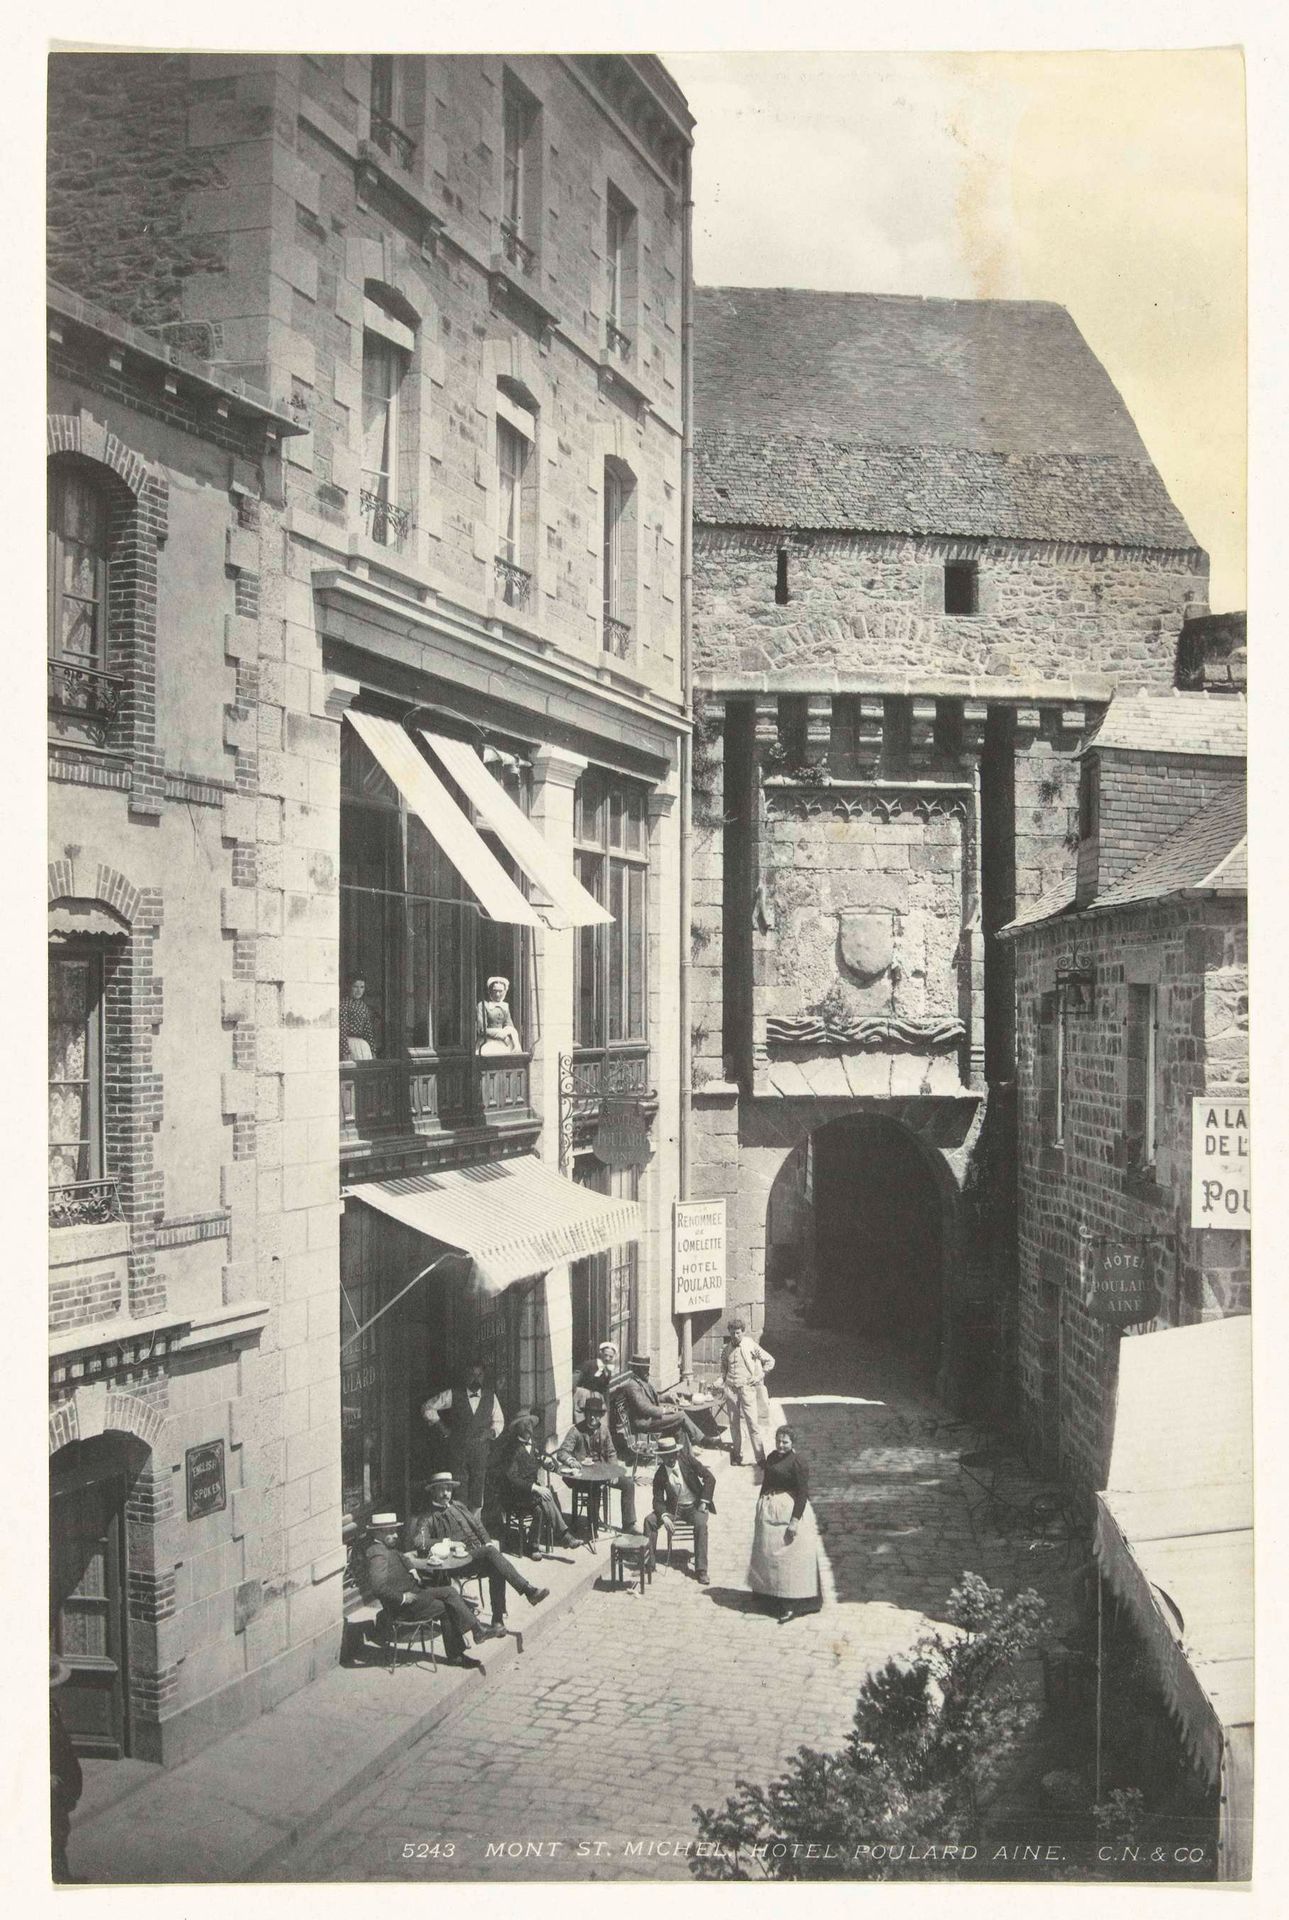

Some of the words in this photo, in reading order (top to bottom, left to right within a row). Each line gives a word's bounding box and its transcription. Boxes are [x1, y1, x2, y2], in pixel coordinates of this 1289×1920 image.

[1205, 1108, 1218, 1128] A
[1225, 1108, 1248, 1128] LA
[1205, 1135, 1230, 1155] DE
[682, 1261, 718, 1274] HOTEL
[677, 1275, 722, 1293] POULARD
[193, 1481, 221, 1500] SPOKEN
